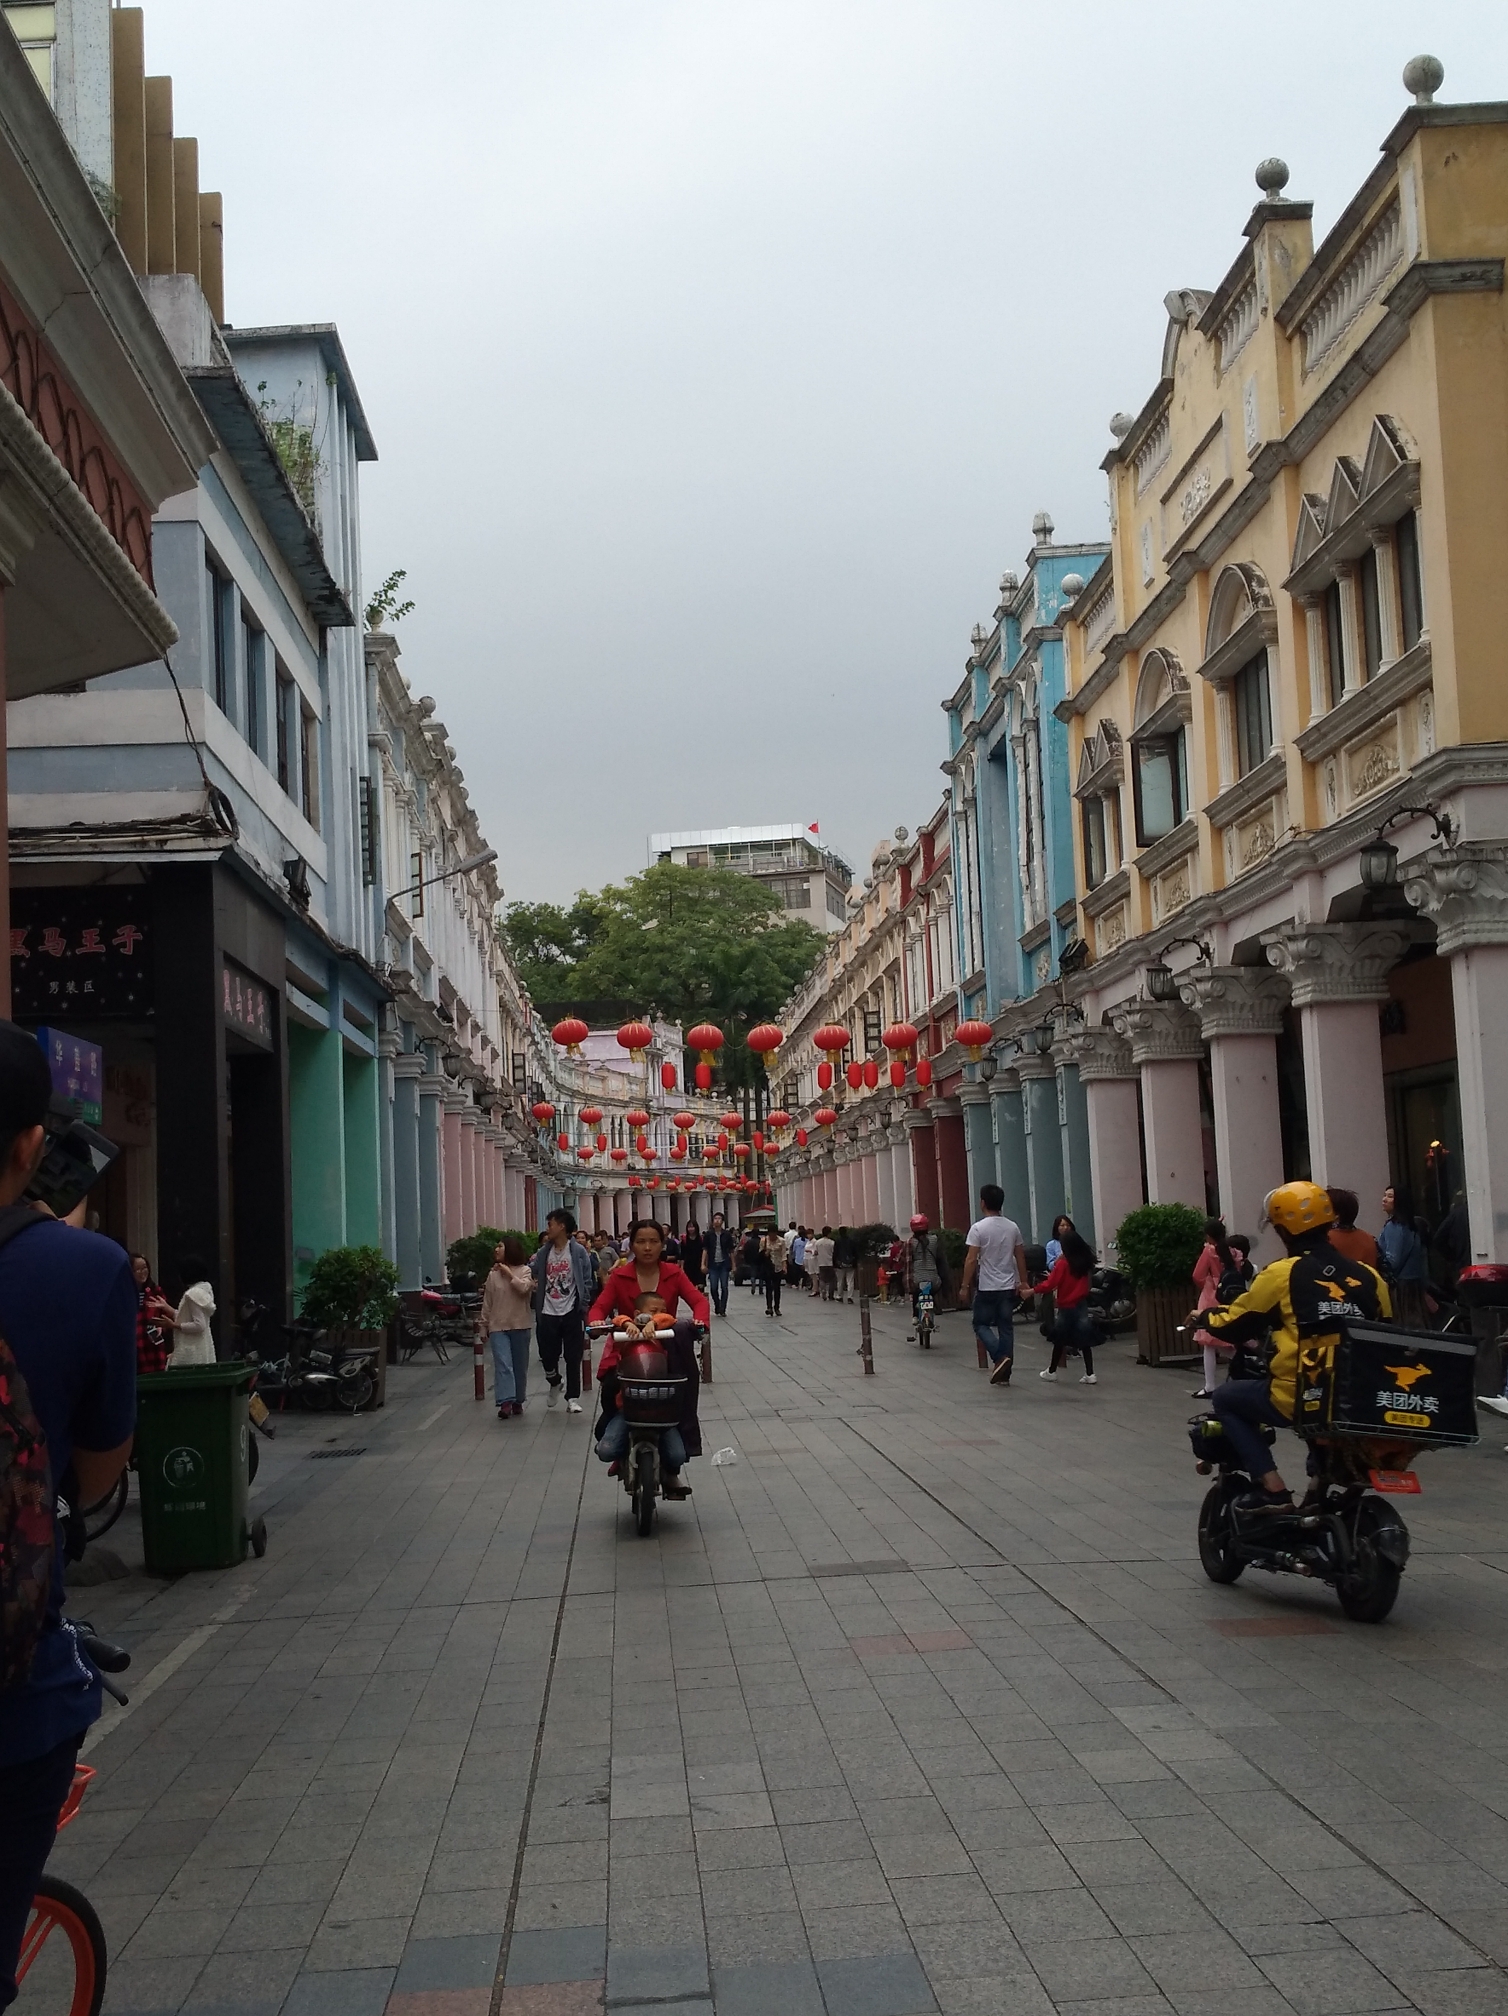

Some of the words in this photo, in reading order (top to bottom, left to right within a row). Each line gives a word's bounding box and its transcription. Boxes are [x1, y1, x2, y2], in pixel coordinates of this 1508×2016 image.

[10, 924, 143, 958] 黑马王子
[48, 980, 95, 994] 男装区
[1375, 1390, 1440, 1414] 美团外卖
